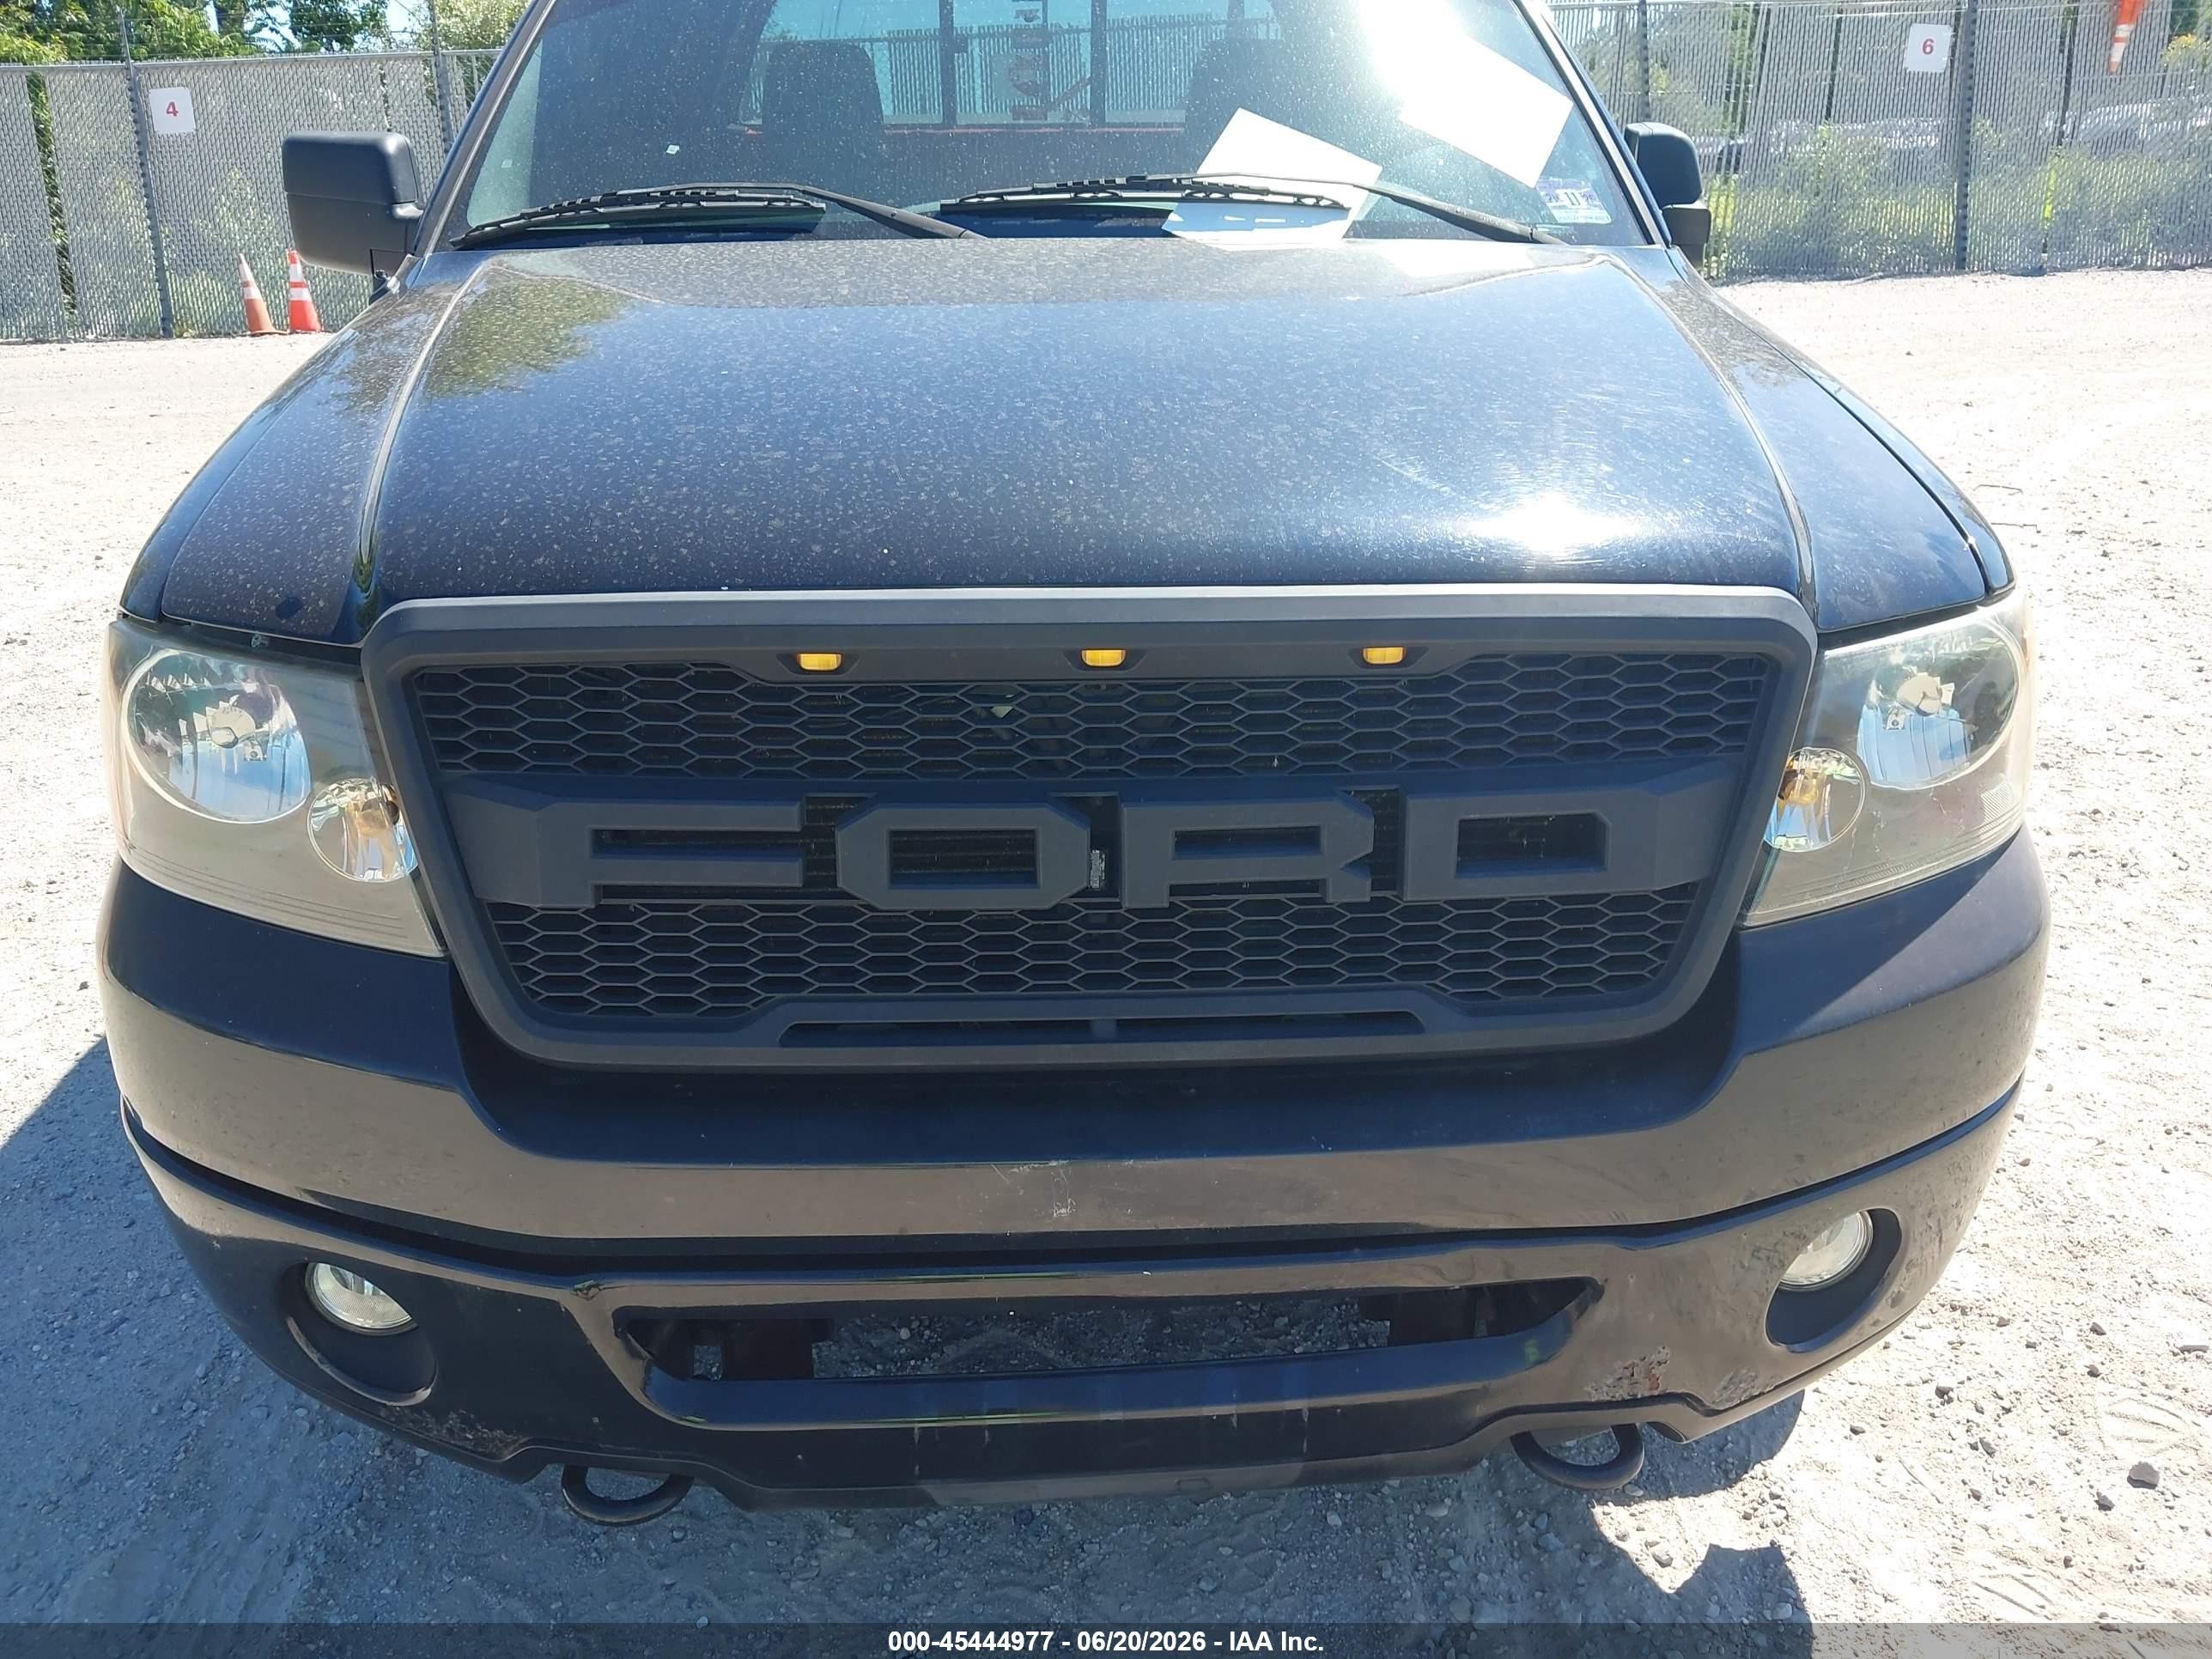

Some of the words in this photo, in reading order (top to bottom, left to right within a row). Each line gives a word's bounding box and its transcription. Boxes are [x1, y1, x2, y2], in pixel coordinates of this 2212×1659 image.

[1922, 38, 1935, 56] 6
[166, 101, 179, 117] 4
[1564, 191, 1581, 206] 11
[534, 788, 1657, 910] FORD
